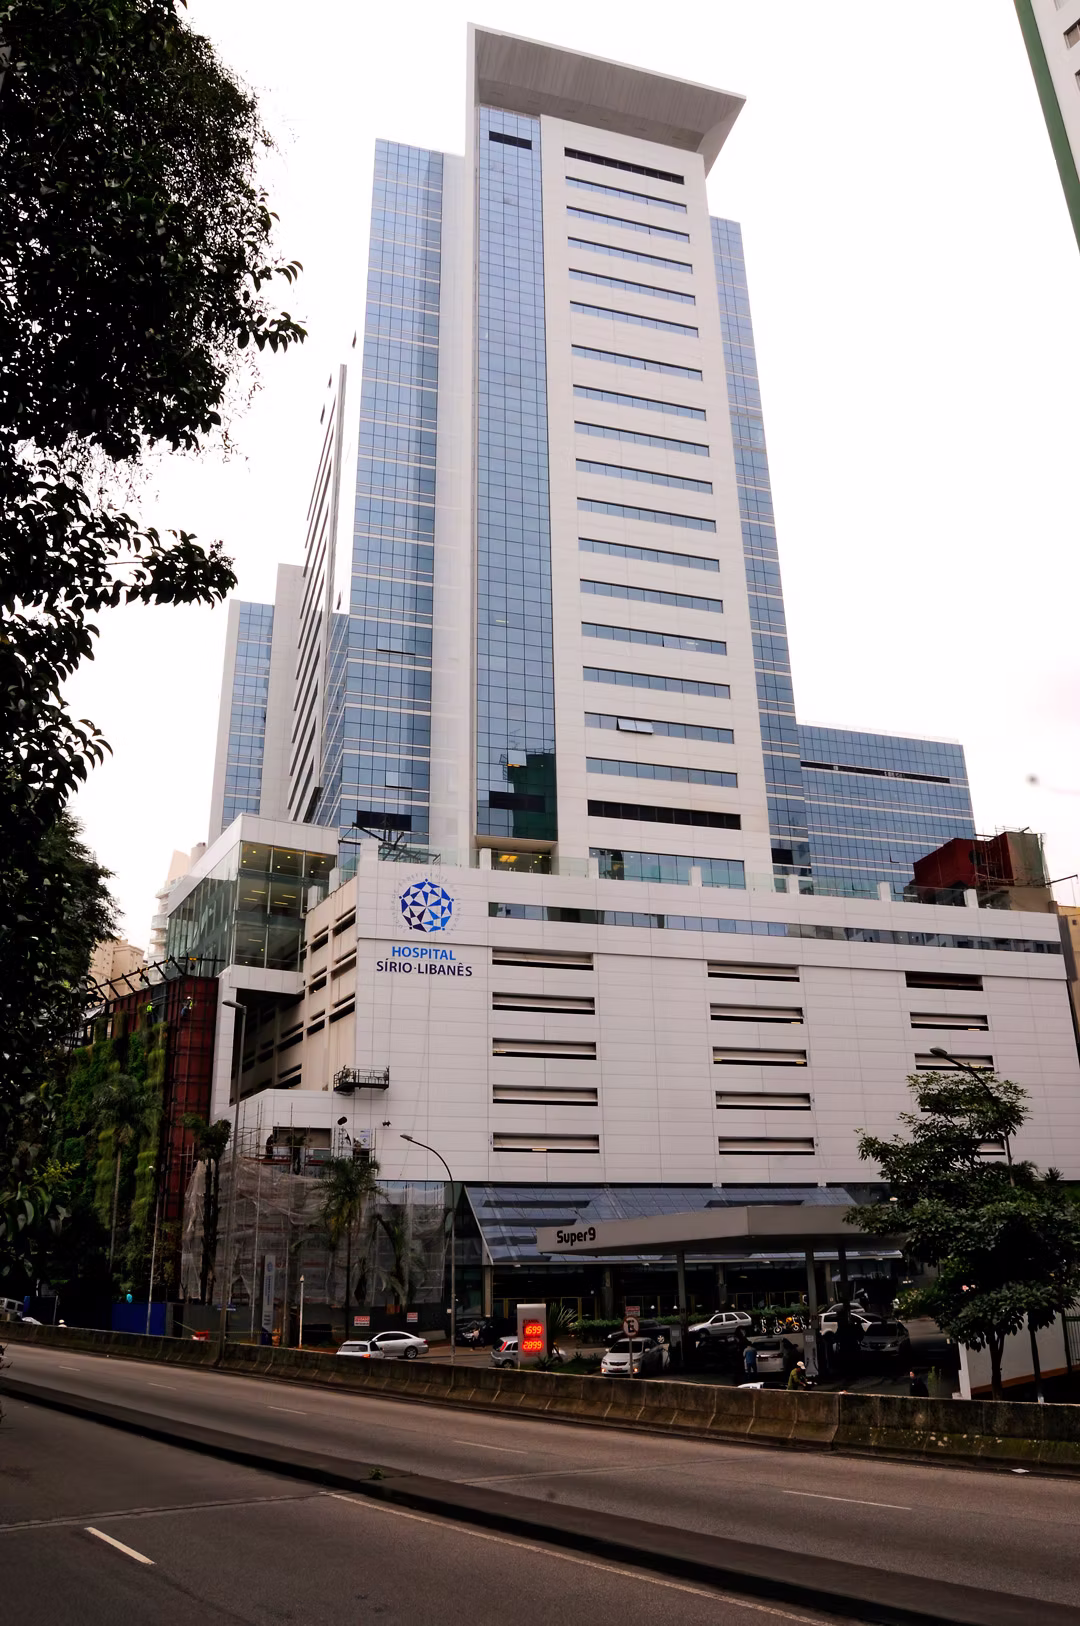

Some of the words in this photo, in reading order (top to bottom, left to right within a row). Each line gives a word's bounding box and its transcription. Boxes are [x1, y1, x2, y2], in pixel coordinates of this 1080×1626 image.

[392, 946, 456, 961] HOSPITAL
[557, 1227, 596, 1246] Super9
[523, 1341, 542, 1350] 2899
